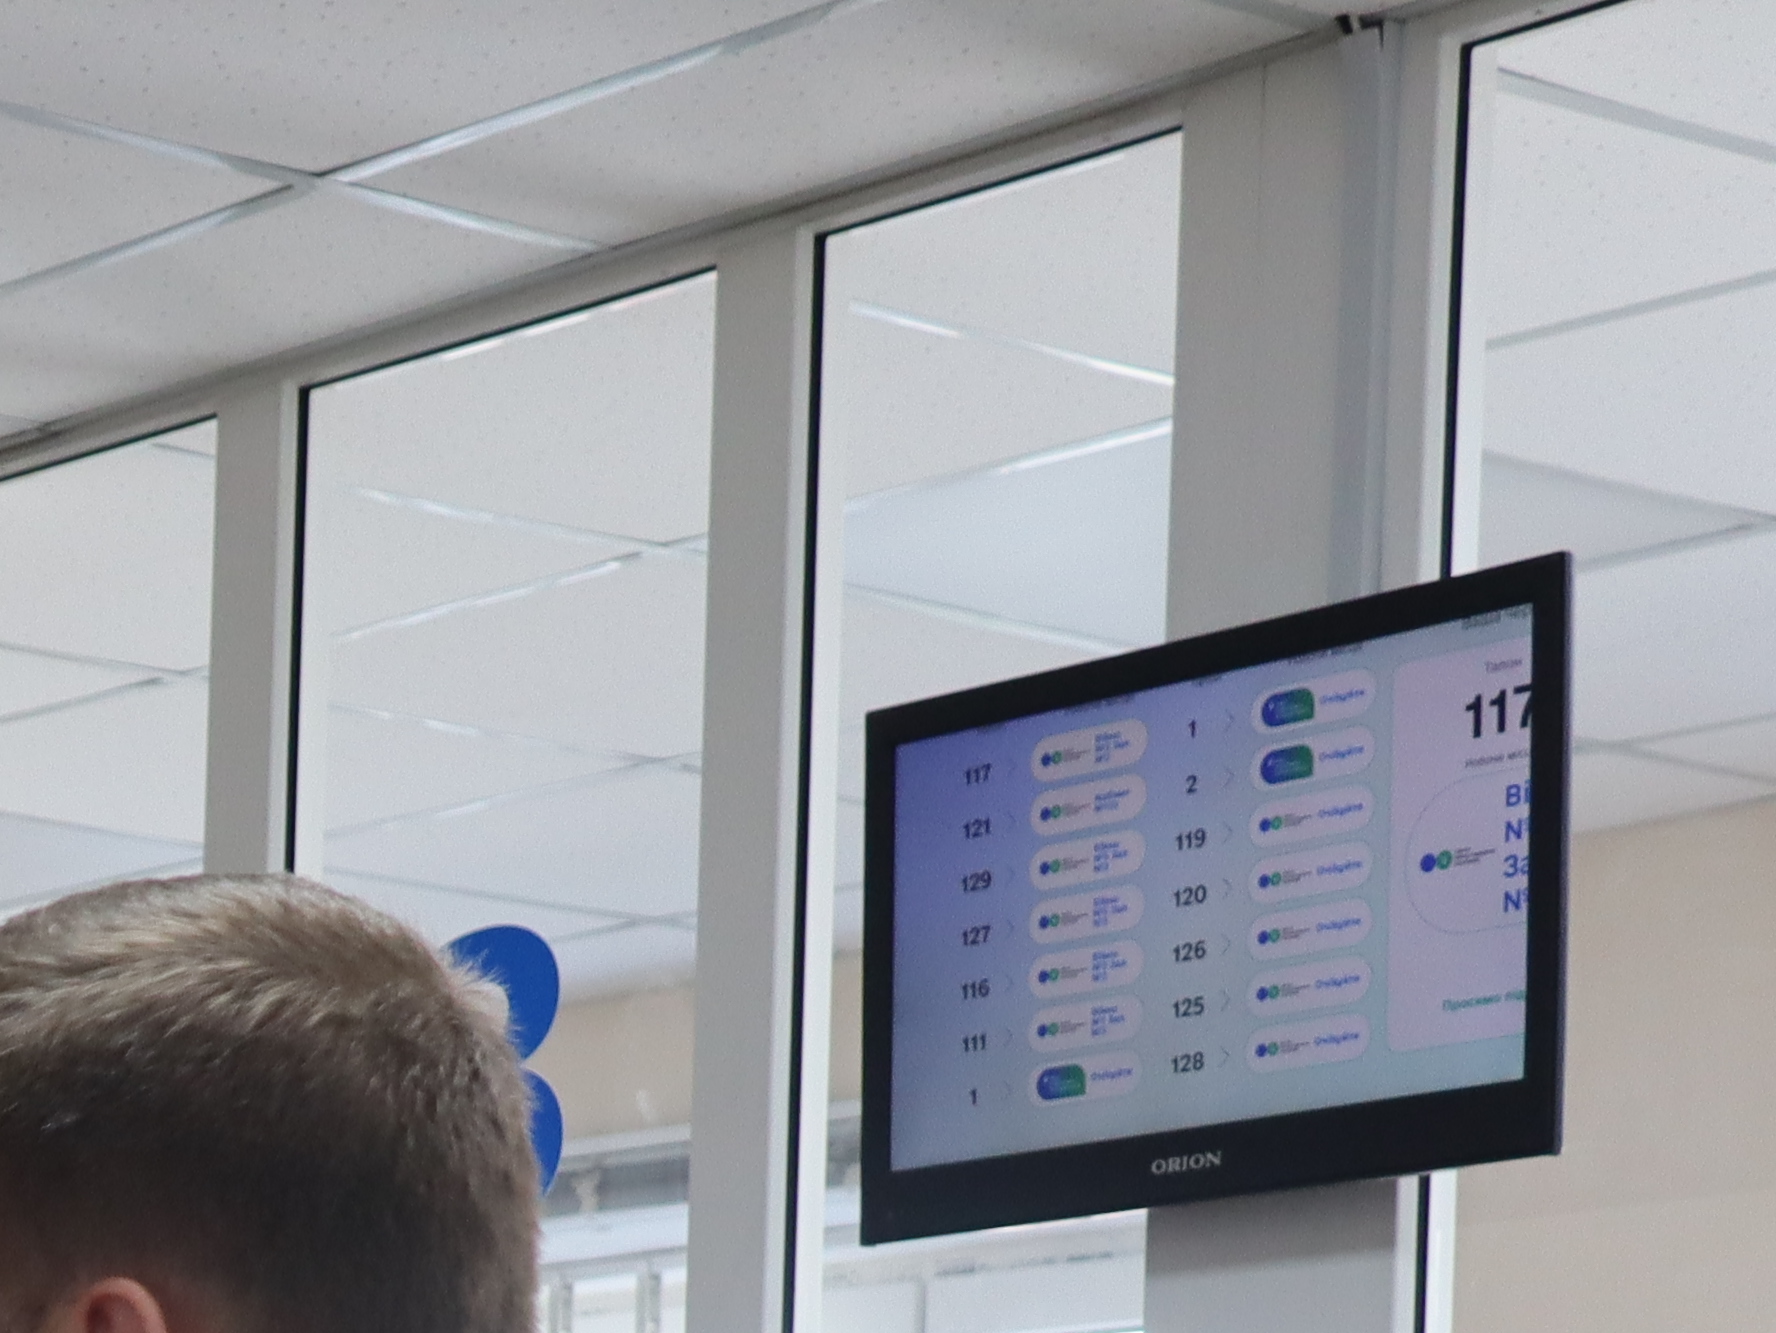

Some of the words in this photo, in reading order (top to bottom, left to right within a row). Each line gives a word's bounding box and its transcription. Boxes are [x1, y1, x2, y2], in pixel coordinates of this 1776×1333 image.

[1465, 683, 1531, 739] 117
[1189, 720, 1196, 738] 1
[965, 763, 991, 785] 117
[1186, 774, 1197, 794] 2
[963, 818, 991, 839] 121
[1176, 828, 1207, 851] 119
[962, 871, 992, 892] 129
[1174, 884, 1207, 907] 120
[962, 925, 991, 946] 127
[1173, 940, 1207, 962] 126
[961, 978, 990, 1000] 116
[1173, 996, 1205, 1018] 125
[962, 1034, 986, 1052] 111
[1172, 1051, 1205, 1073] 128
[970, 1088, 977, 1105] 1
[1151, 1150, 1222, 1174] ORION
